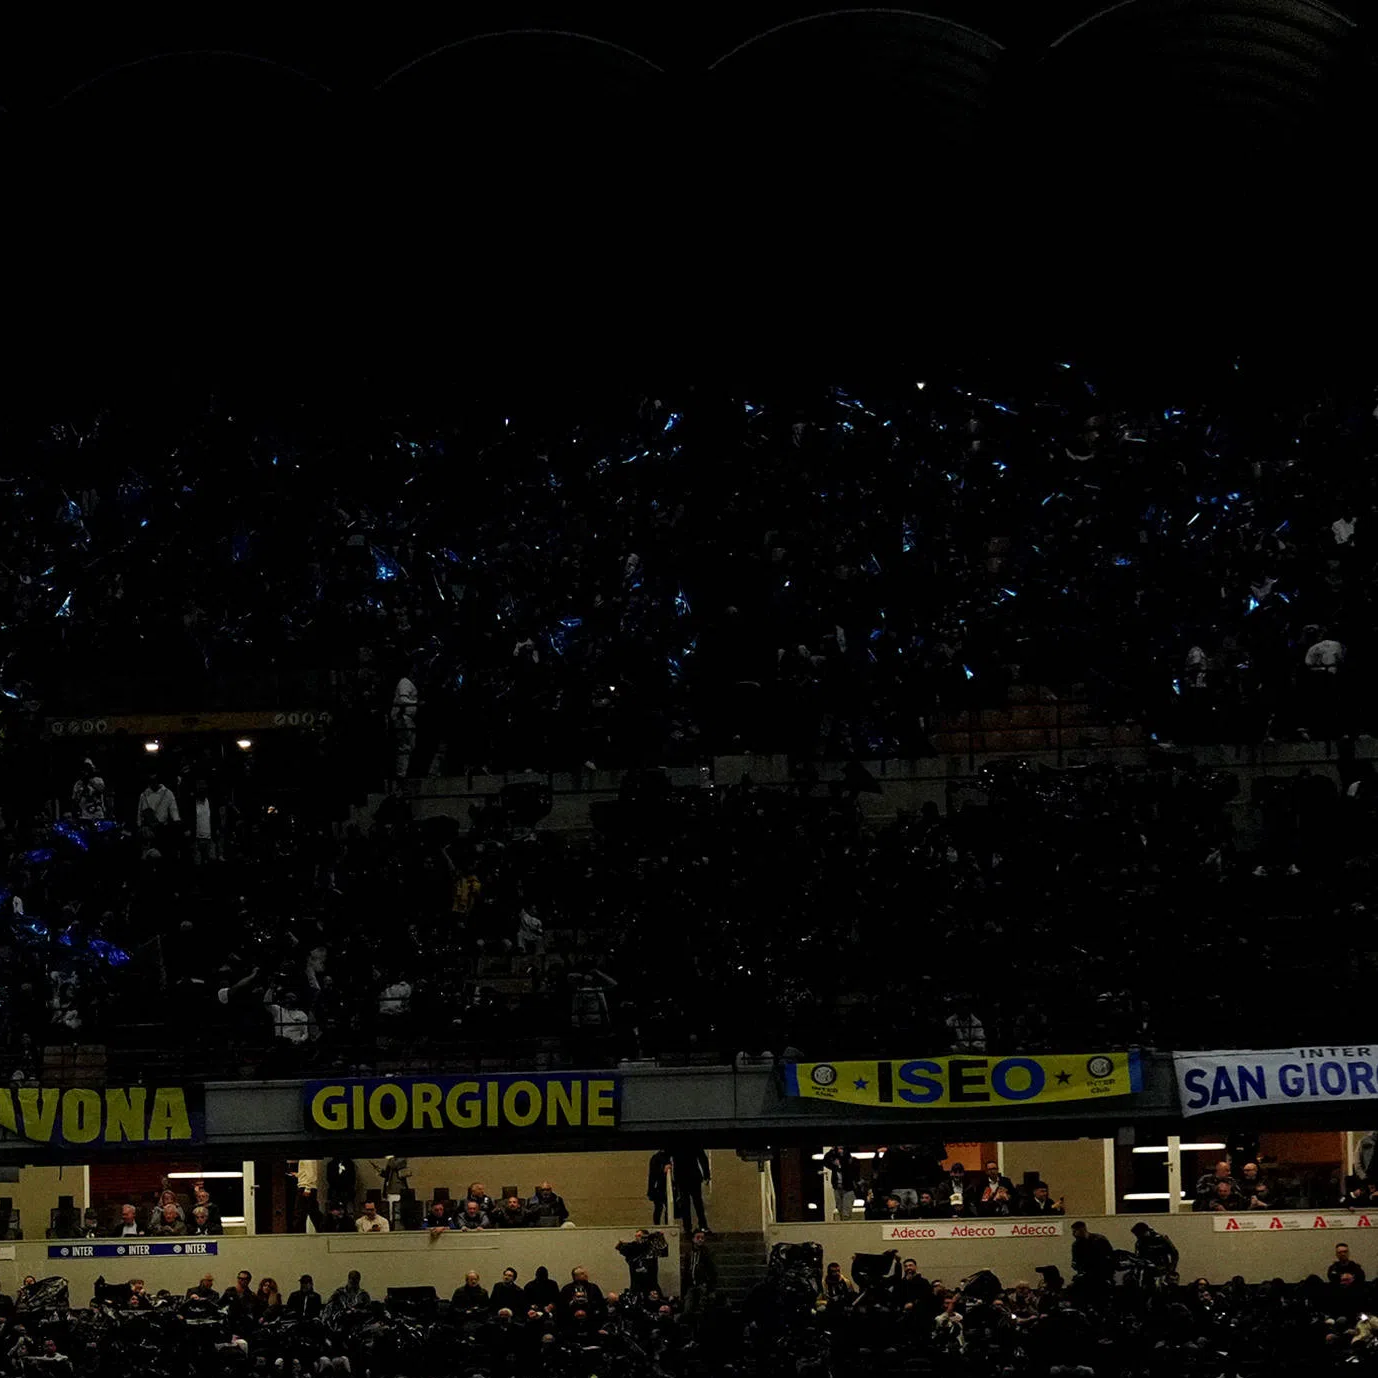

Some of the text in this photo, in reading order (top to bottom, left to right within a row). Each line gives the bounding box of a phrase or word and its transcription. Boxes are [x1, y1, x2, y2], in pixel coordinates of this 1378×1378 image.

[1299, 1047, 1372, 1058] INTER
[878, 1057, 1045, 1103] ISEO
[1184, 1061, 1378, 1109] SAN GIOR
[311, 1080, 615, 1130] GIORGIONE
[891, 1227, 935, 1239] Adecco
[951, 1226, 996, 1237] Adecco
[1011, 1225, 1056, 1236] Adecco
[72, 1245, 94, 1257] INTER
[128, 1244, 150, 1256] INTER
[185, 1243, 207, 1255] INTER
